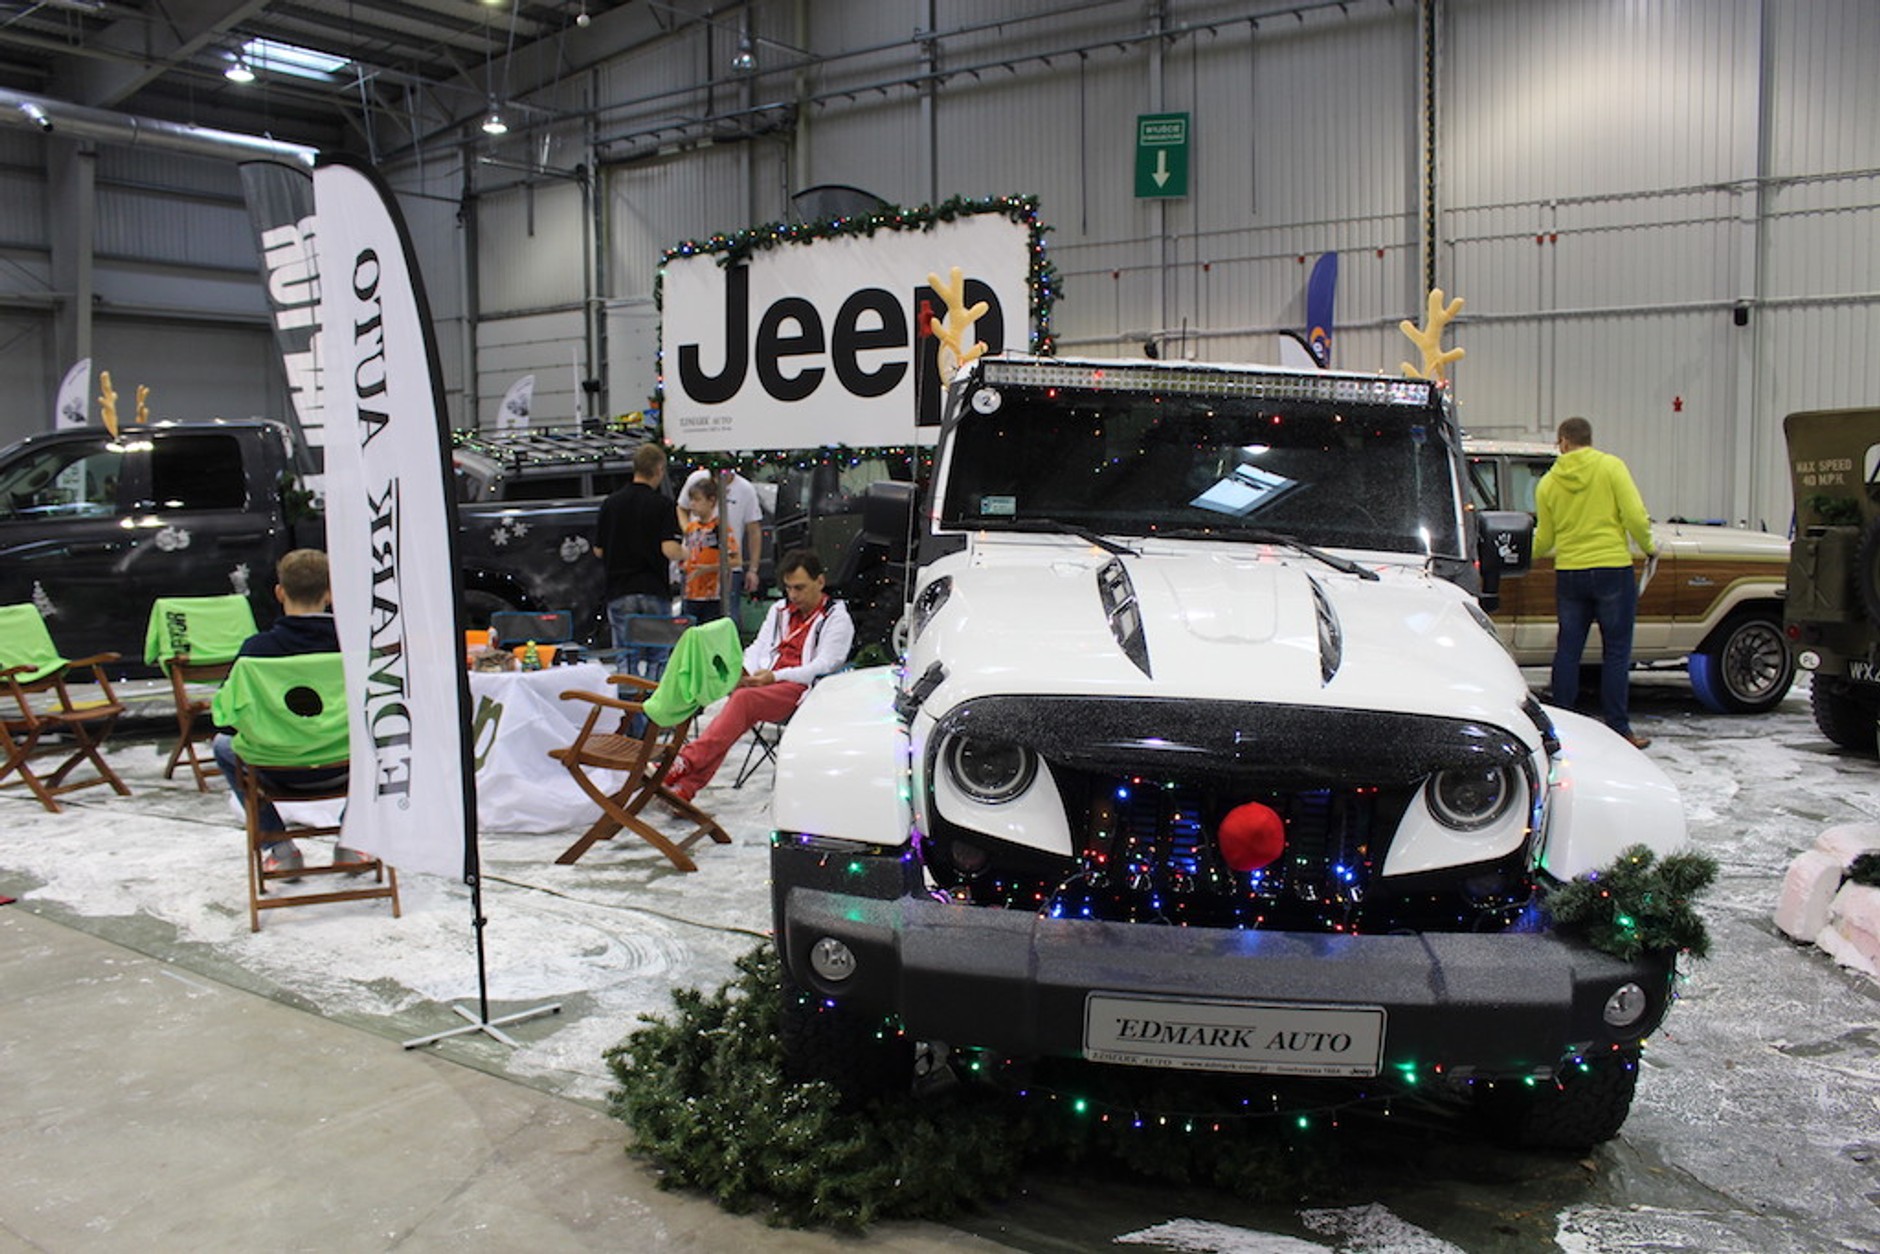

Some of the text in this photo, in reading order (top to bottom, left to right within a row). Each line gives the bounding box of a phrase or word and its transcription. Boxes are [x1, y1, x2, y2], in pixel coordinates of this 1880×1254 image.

[678, 264, 1005, 427] Jeep
[1819, 458, 1852, 472] SPEED
[1802, 654, 1817, 665] PL
[1115, 1018, 1352, 1053] EDMARK AUTO
